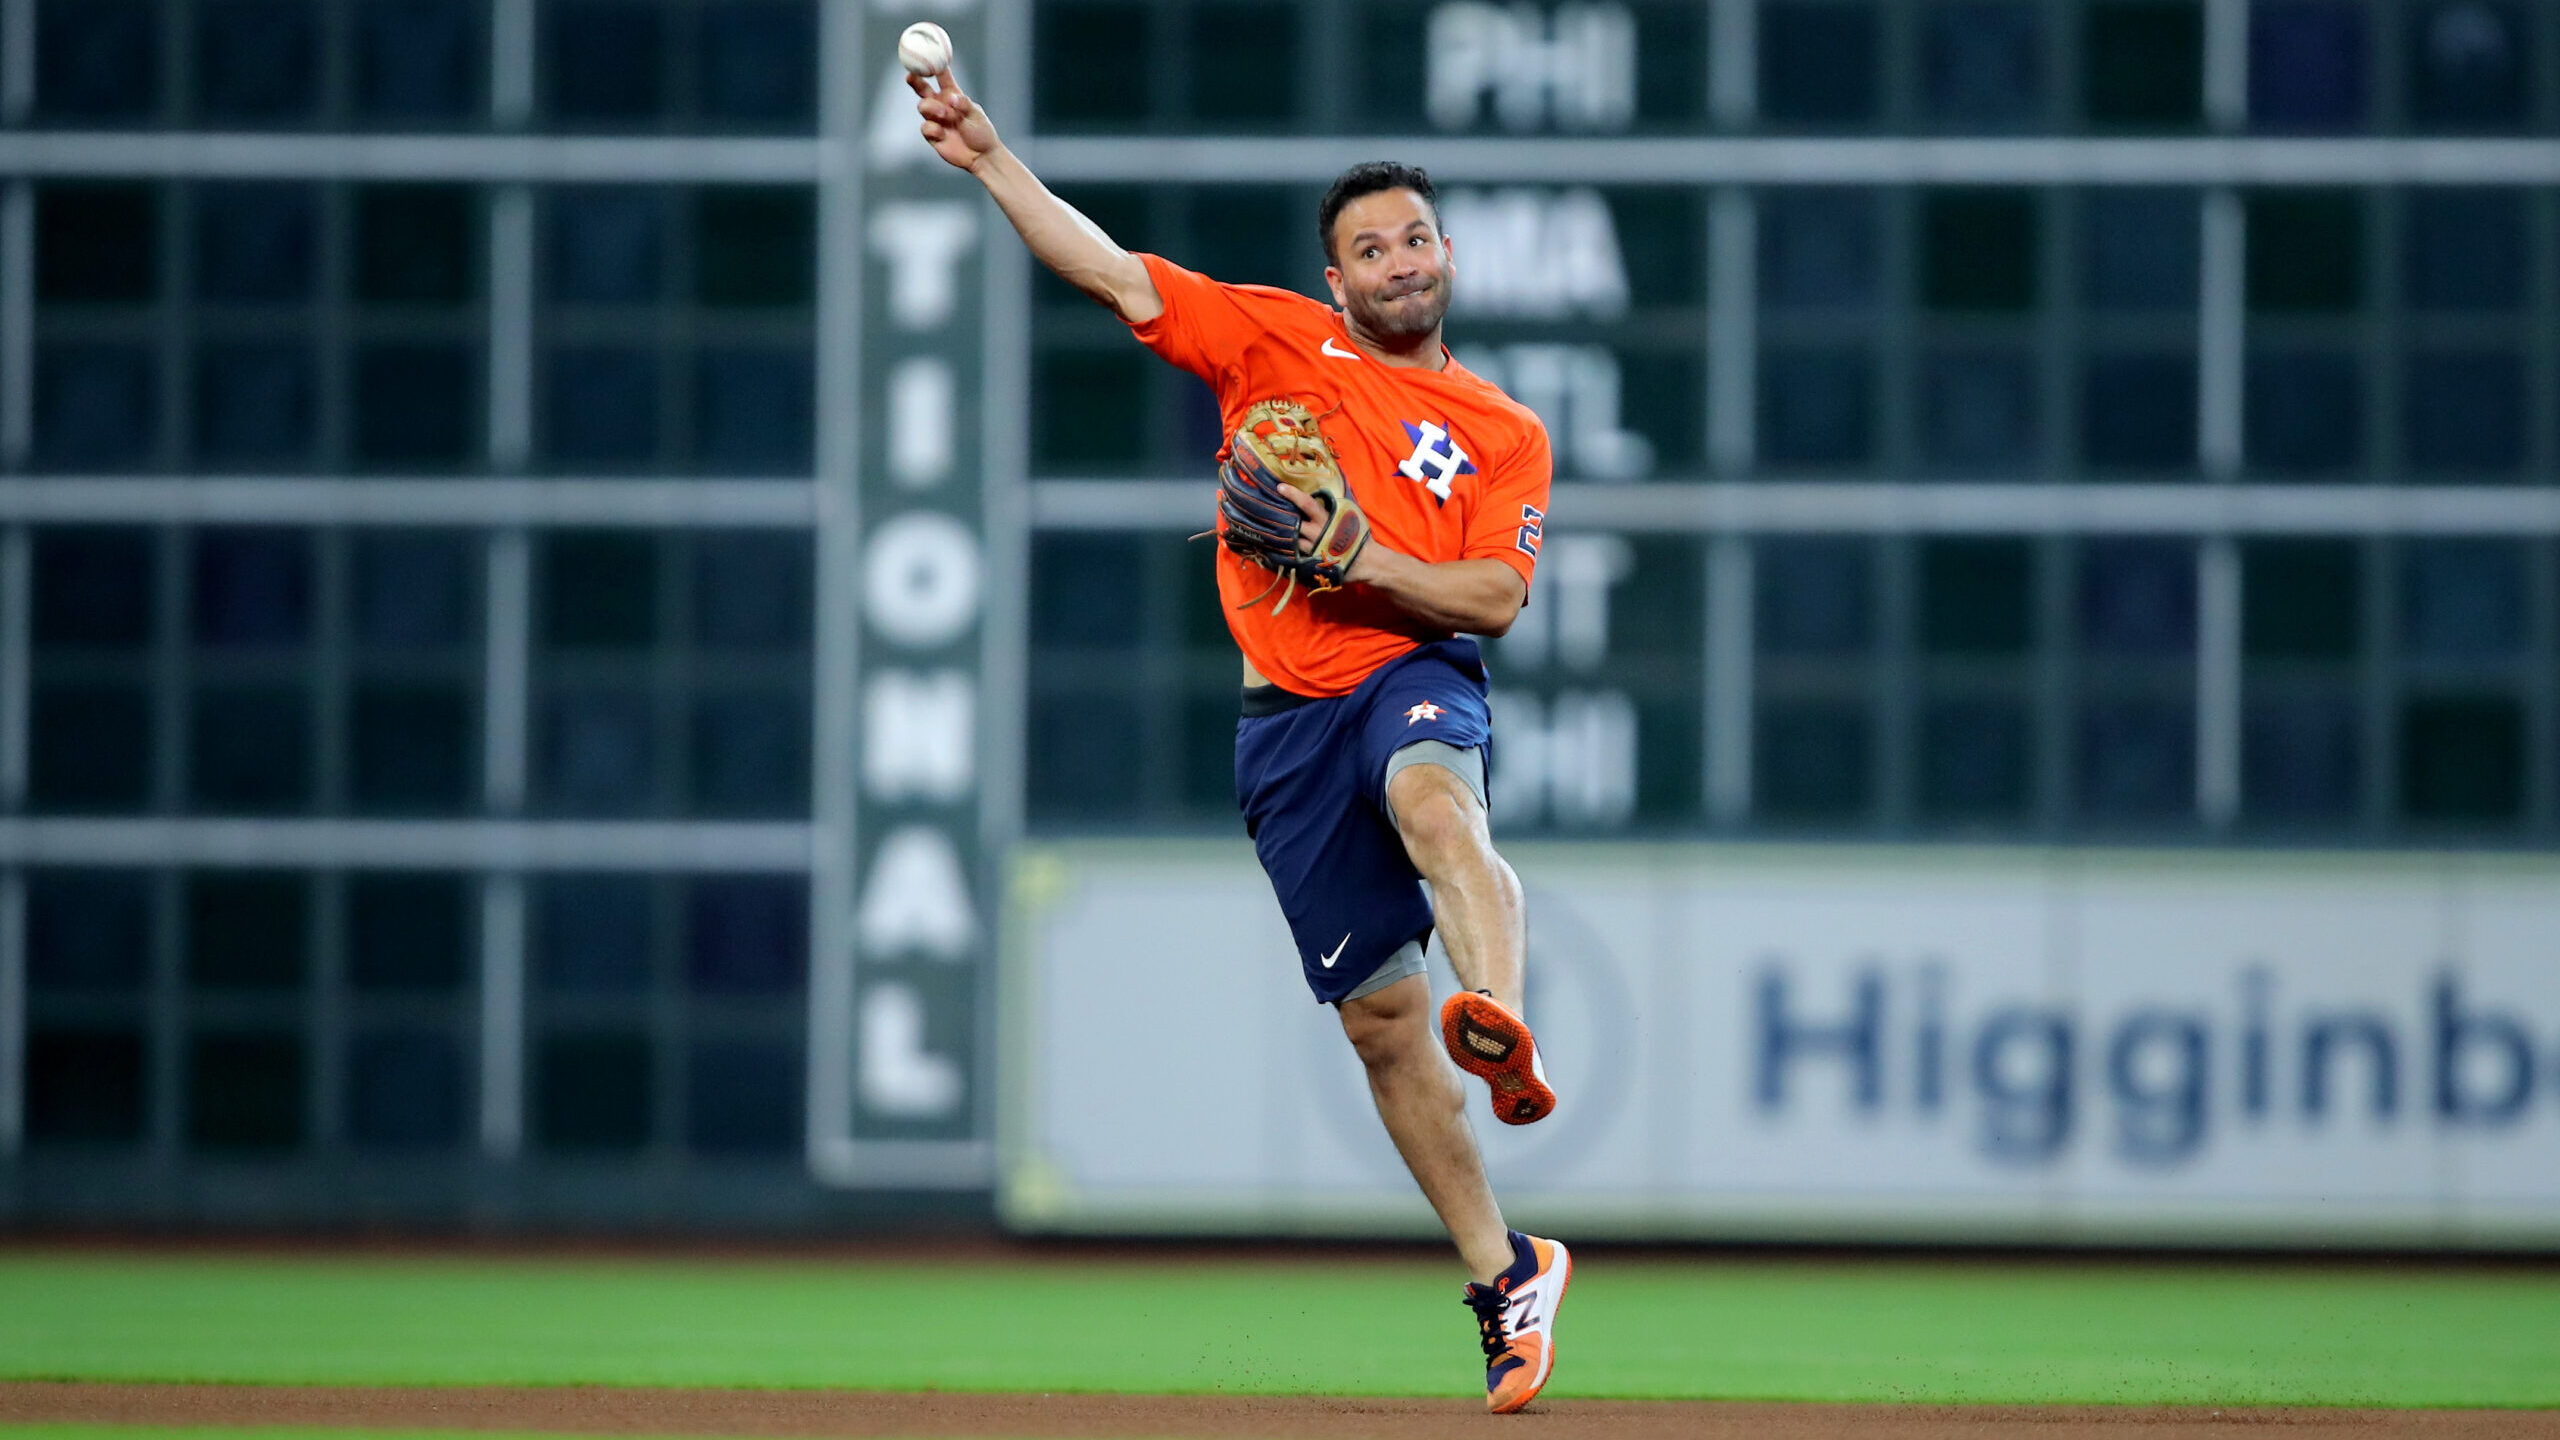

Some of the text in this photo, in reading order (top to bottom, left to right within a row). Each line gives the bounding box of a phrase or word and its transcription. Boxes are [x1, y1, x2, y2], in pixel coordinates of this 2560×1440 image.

[1426, 4, 1638, 130] PHI
[1398, 420, 1468, 499] H
[867, 0, 977, 1115] ATIONAL
[1752, 958, 2560, 1172] Higginb
